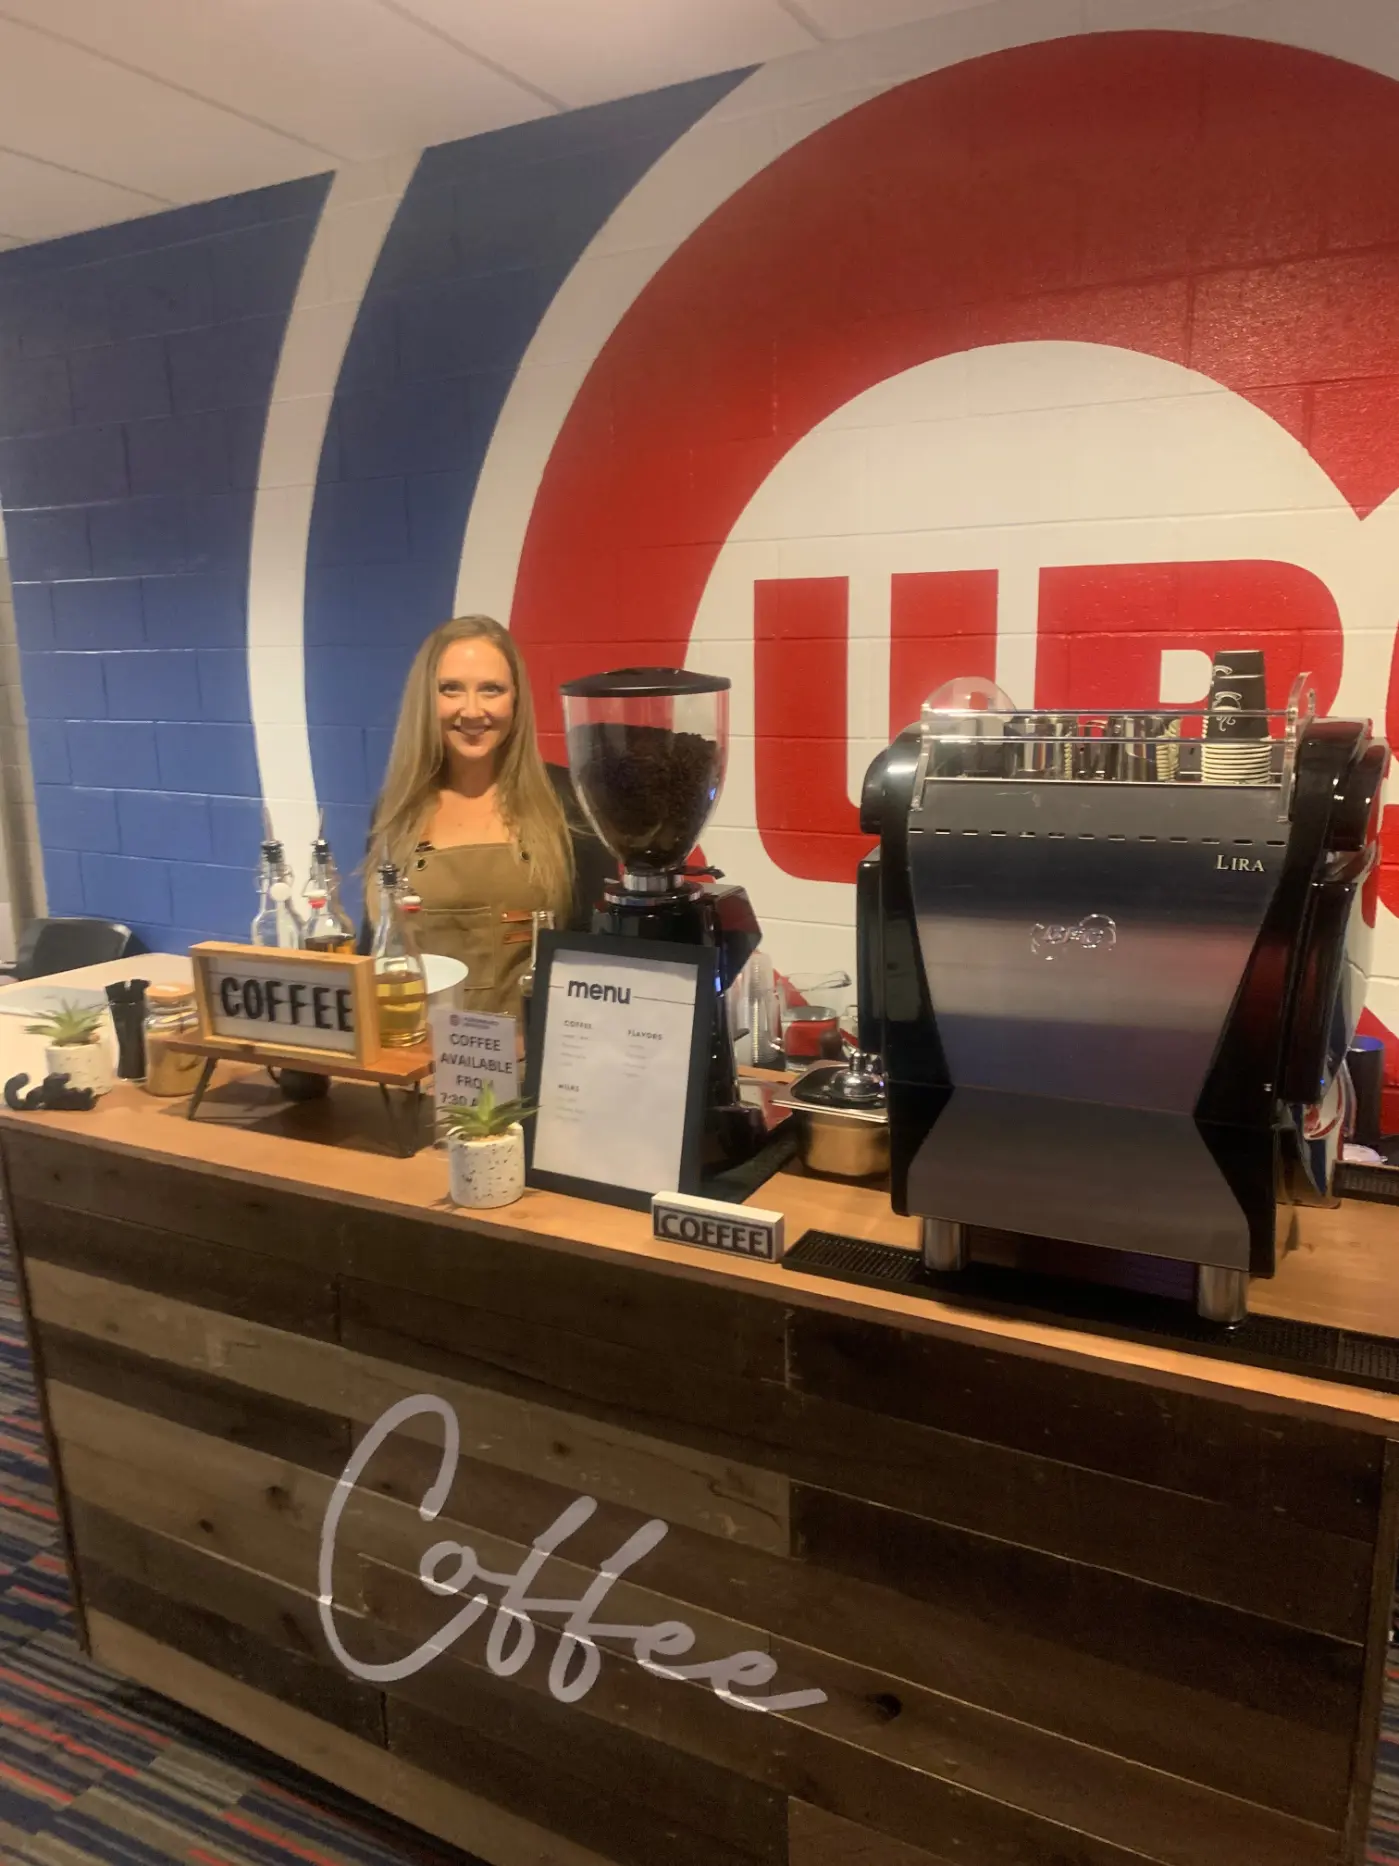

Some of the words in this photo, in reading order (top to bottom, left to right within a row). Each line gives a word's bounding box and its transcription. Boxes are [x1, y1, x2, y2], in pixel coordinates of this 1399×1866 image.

[1216, 854, 1266, 873] LIRA
[220, 976, 355, 1032] COFFEE
[567, 979, 632, 1005] menu
[449, 1033, 502, 1052] COFFEE
[627, 1029, 664, 1041] FLAVORS
[440, 1052, 514, 1075] AVAILABLE
[661, 1213, 764, 1256] COFFEE
[319, 1393, 828, 1711] Coffee
